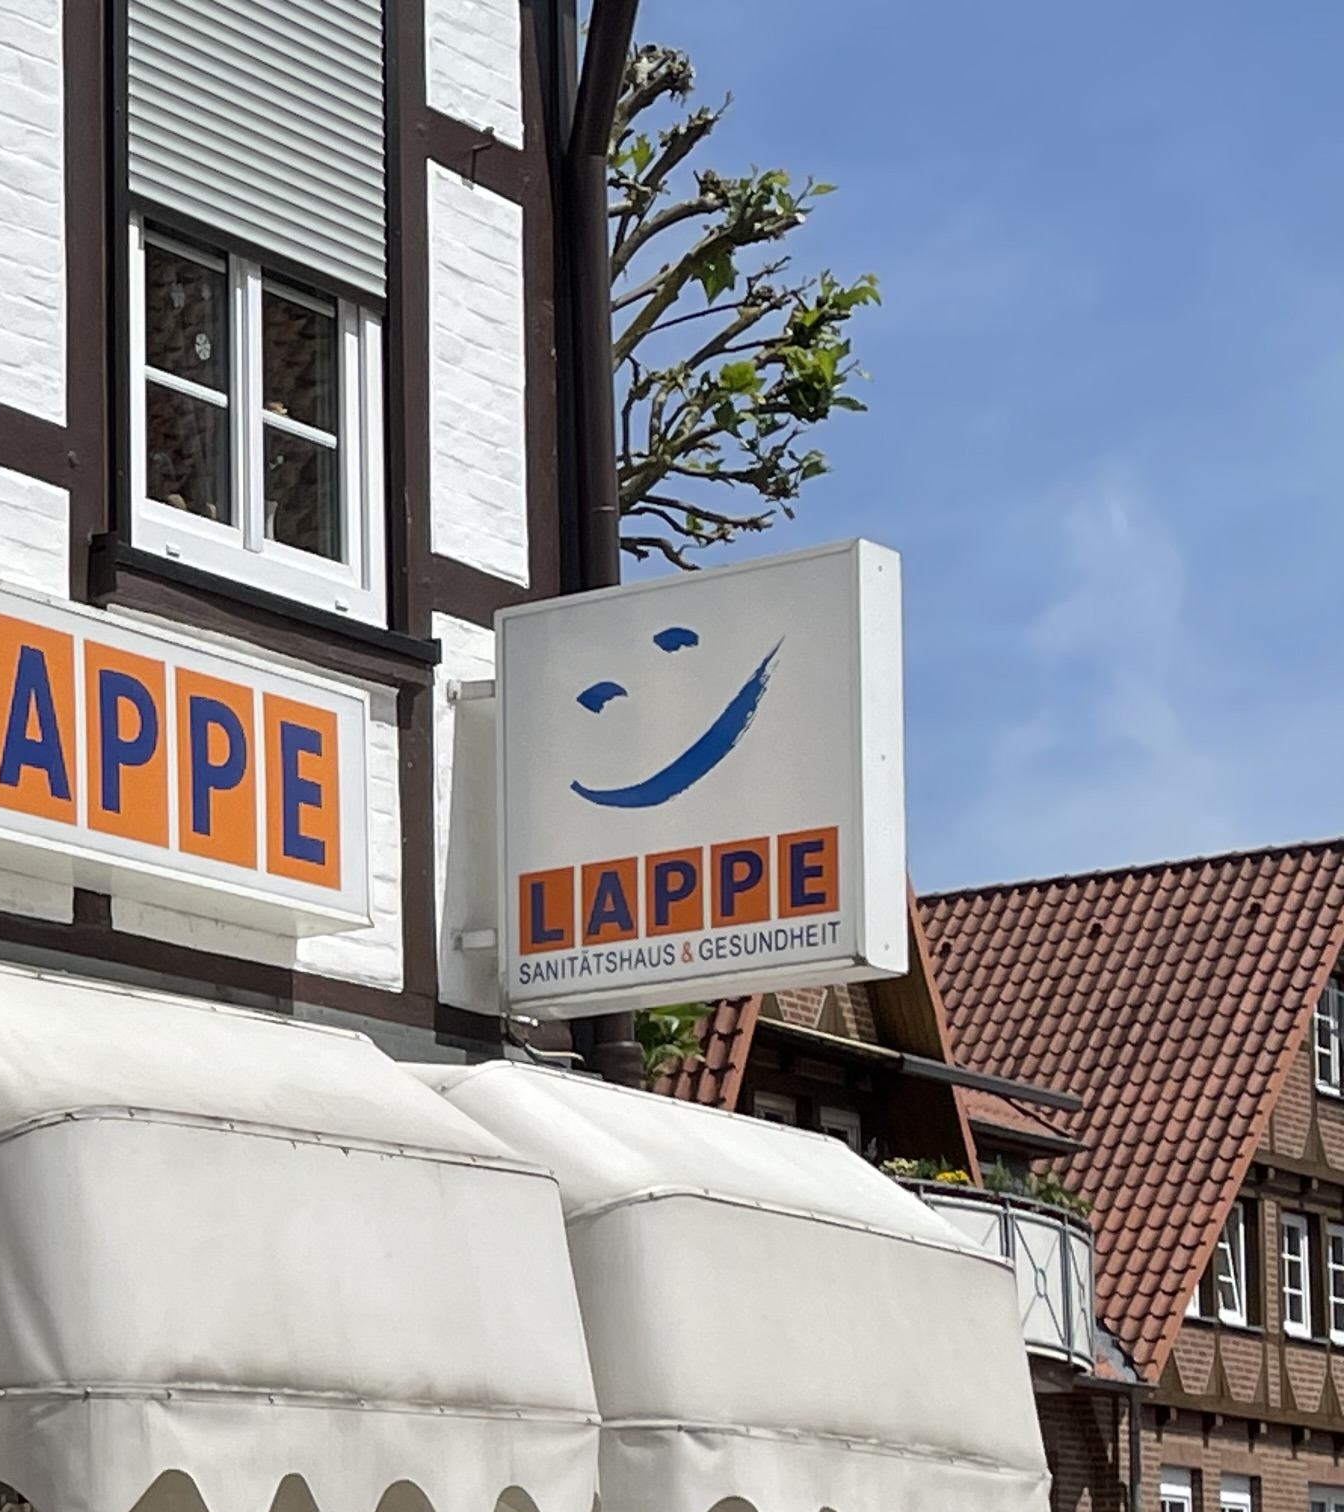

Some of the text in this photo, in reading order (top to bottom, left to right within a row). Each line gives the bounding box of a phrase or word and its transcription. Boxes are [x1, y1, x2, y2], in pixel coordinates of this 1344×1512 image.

[530, 839, 826, 944] LAPPE
[519, 921, 842, 984] SANITÄTSHAUS & GESUNDHEIT
